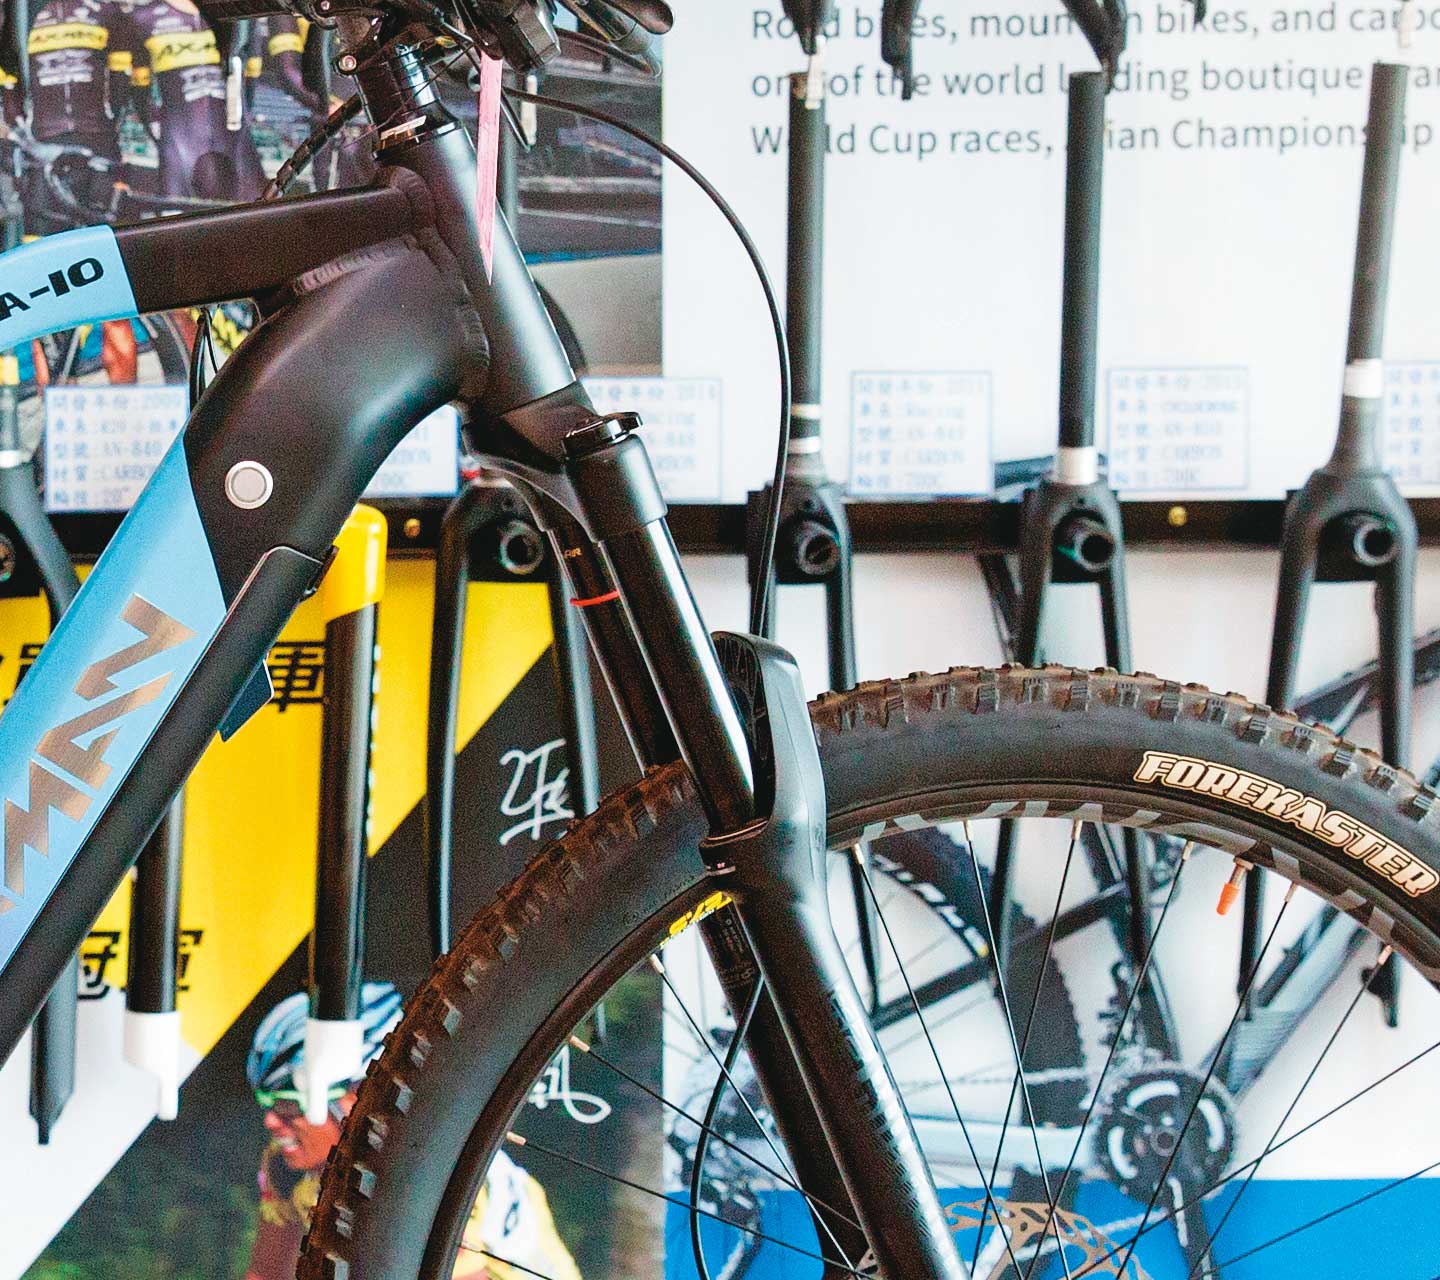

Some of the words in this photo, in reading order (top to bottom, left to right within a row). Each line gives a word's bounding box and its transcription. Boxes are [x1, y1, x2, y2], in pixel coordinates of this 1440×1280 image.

[752, 7, 841, 40] Rod
[1270, 1, 1336, 33] and
[943, 62, 1046, 95] world
[1058, 61, 1190, 104] lding
[1194, 58, 1364, 98] boutique
[751, 123, 856, 156] Wld
[869, 124, 938, 161] Cup
[950, 127, 1054, 158] races,
[1132, 750, 1440, 898] FOREKASTER
